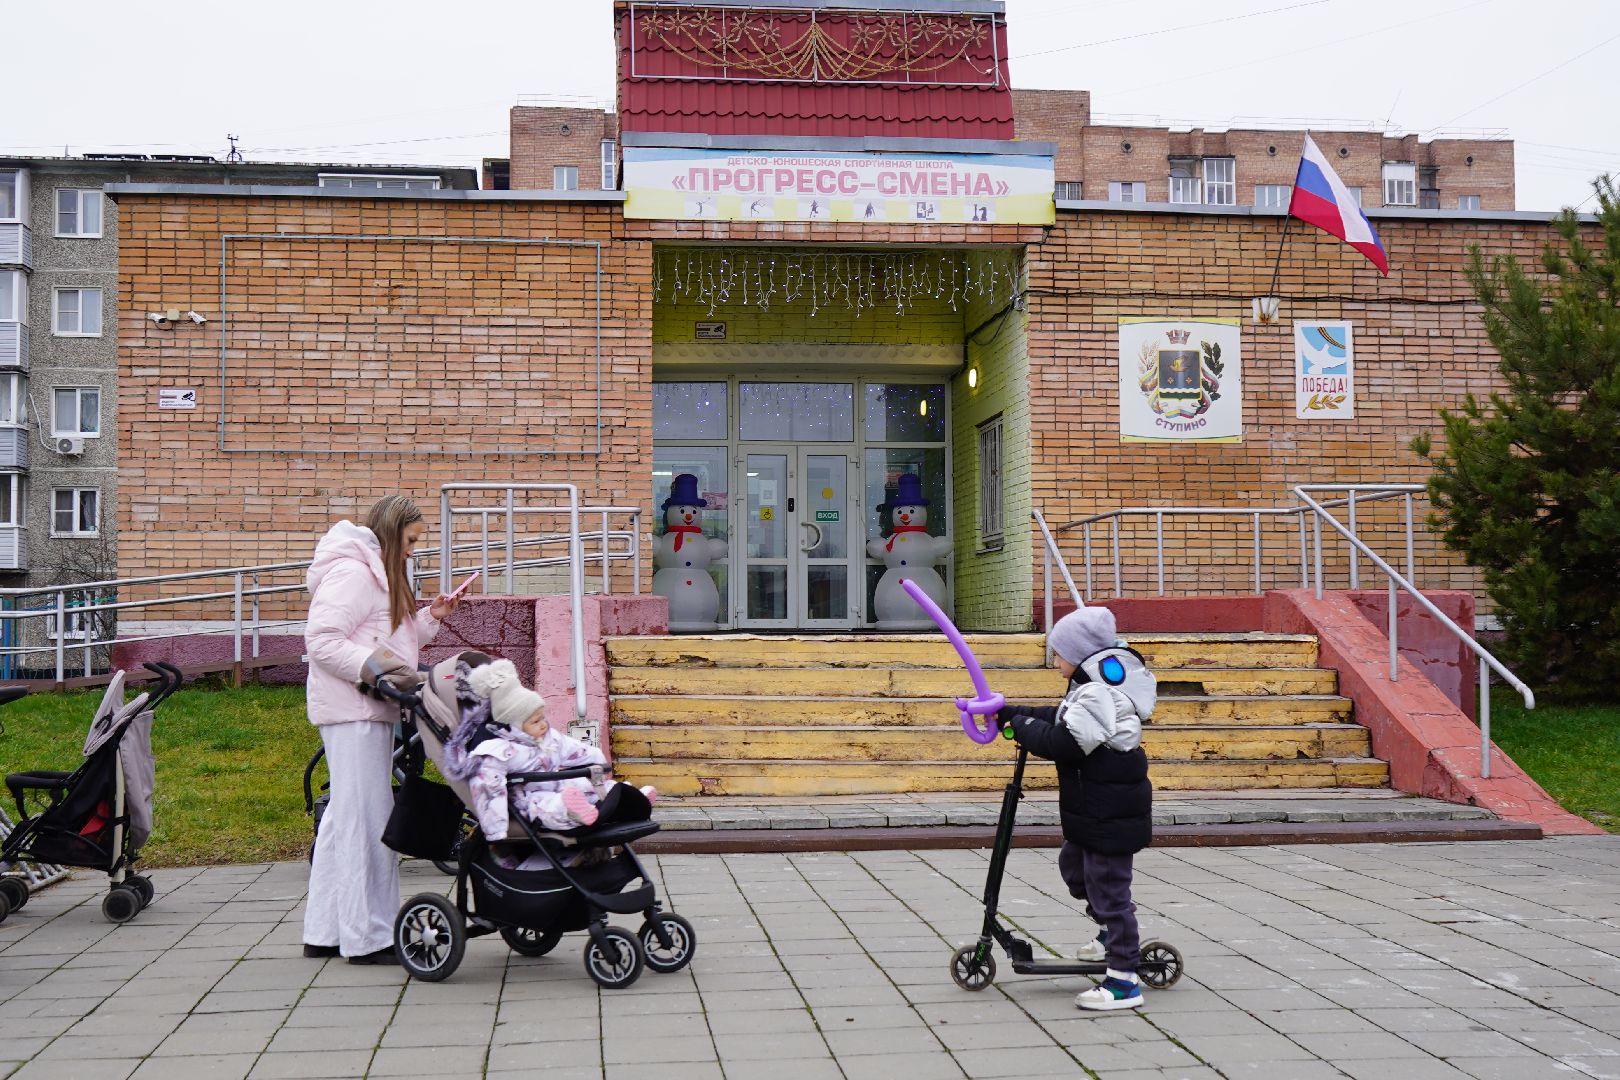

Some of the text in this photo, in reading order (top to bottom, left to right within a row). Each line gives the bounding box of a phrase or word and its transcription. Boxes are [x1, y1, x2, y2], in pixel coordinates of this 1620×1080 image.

[728, 157, 954, 169] ДЕТСКО-ЮНОШЕСКАЯ СПОРТИВНАЯ ШКОЛА
[672, 167, 1010, 196] «ПРОГРЕСС-СМЕНА»
[1302, 377, 1348, 393] ПОБЕДА!
[1155, 417, 1207, 432] СТУПИНО
